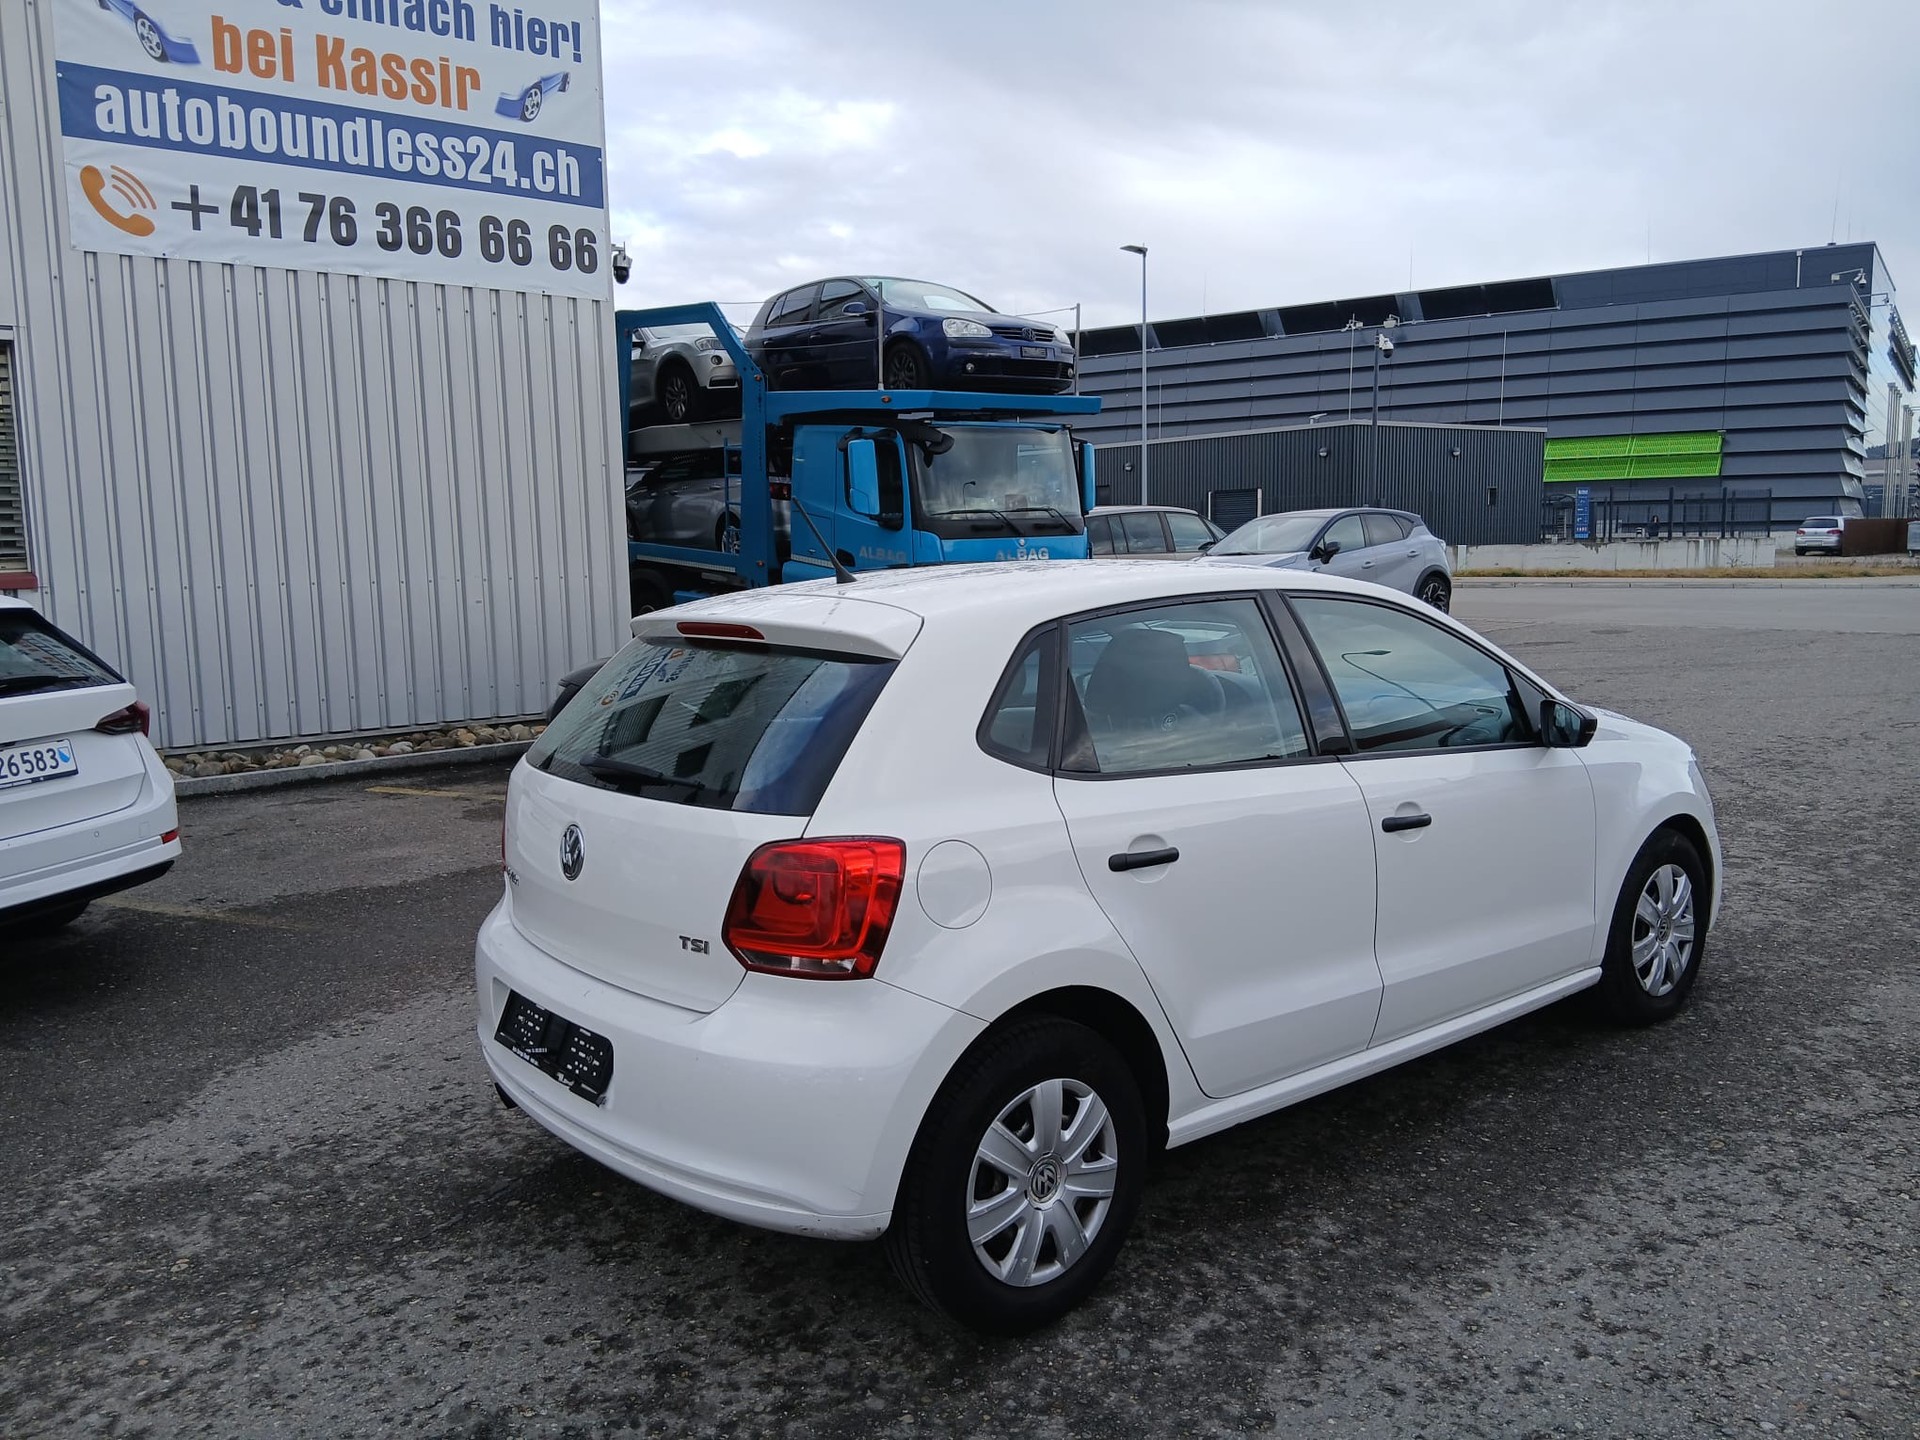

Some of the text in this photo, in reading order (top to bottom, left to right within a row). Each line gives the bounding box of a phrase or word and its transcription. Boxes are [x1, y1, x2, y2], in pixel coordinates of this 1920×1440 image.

[211, 15, 481, 111] bei Kassir
[489, 4, 582, 63] hier!
[94, 84, 581, 197] autoboundless24.ch
[298, 192, 358, 247] 76
[375, 202, 462, 259] 366
[479, 215, 533, 267] 66
[548, 224, 598, 274] 66
[994, 547, 1050, 561] ALBAG
[678, 935, 710, 955] TSI
